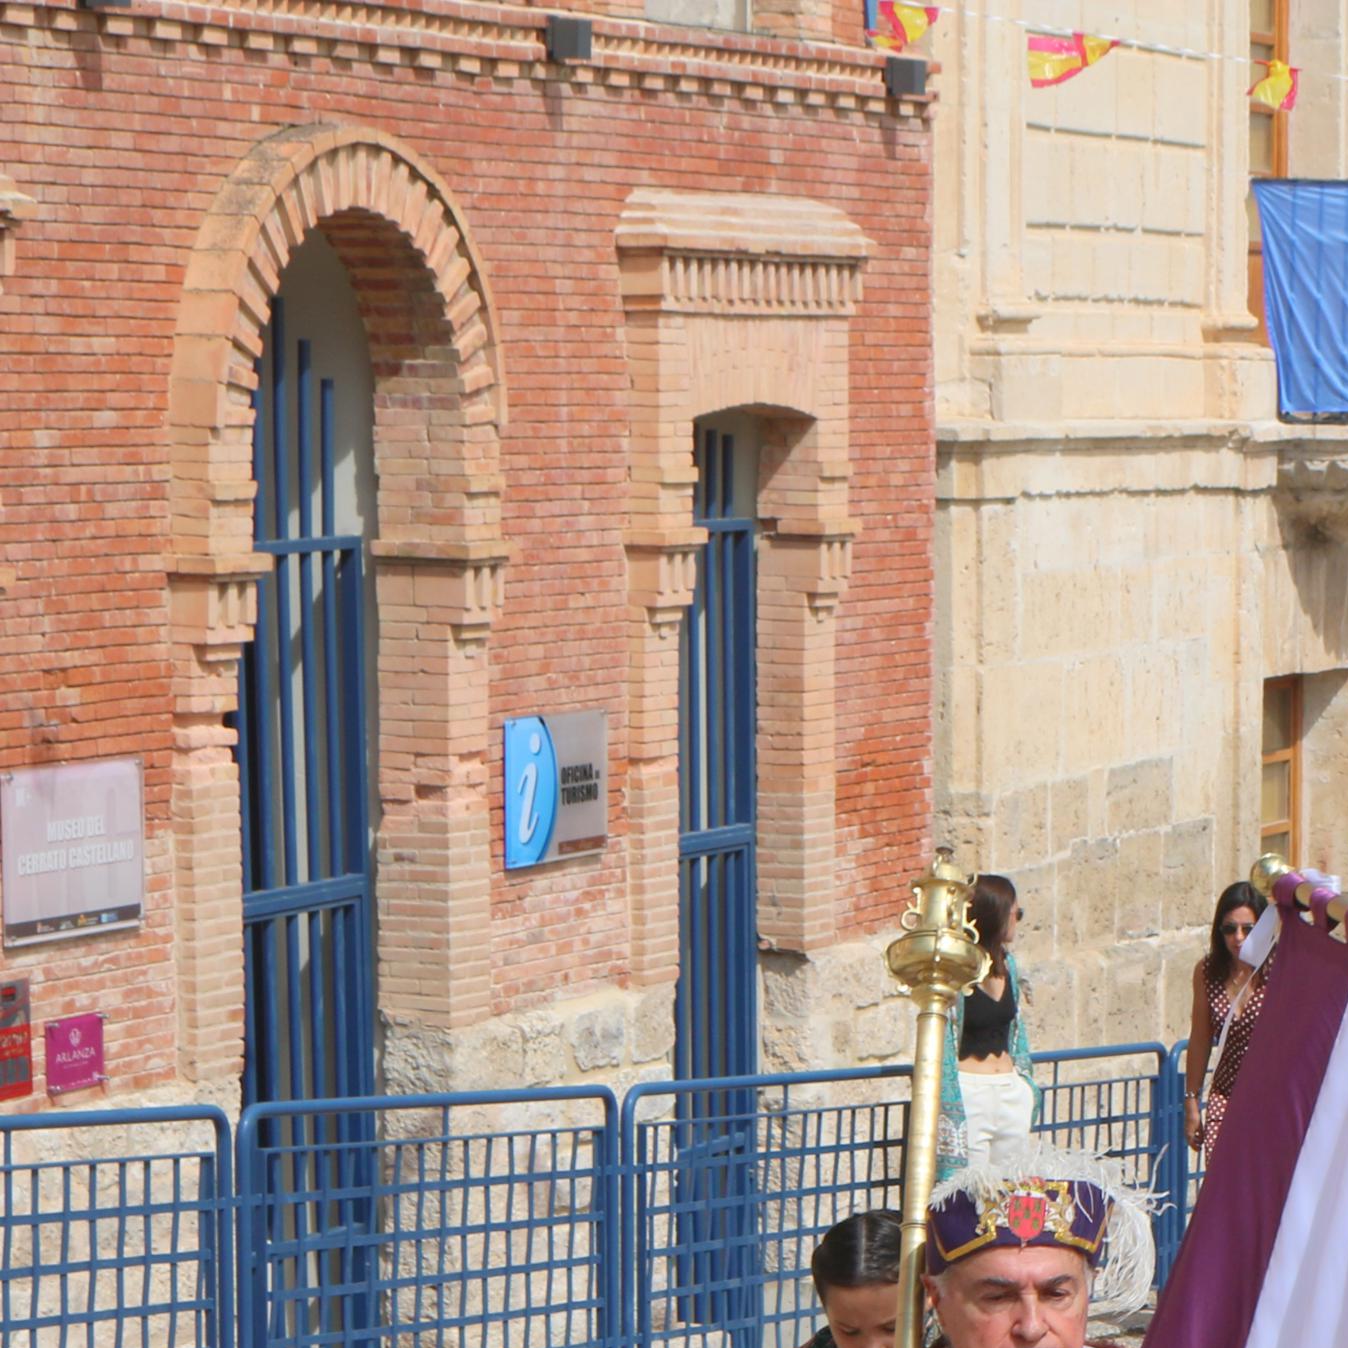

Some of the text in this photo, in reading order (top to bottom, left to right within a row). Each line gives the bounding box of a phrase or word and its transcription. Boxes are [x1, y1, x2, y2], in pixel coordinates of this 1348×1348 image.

[560, 763, 593, 785] OFICINA
[561, 782, 599, 806] TURISMO
[47, 815, 105, 842] MUSEO DEL
[18, 839, 134, 876] CERRATO CASTELLANO
[55, 1046, 96, 1064] ARLANZA
